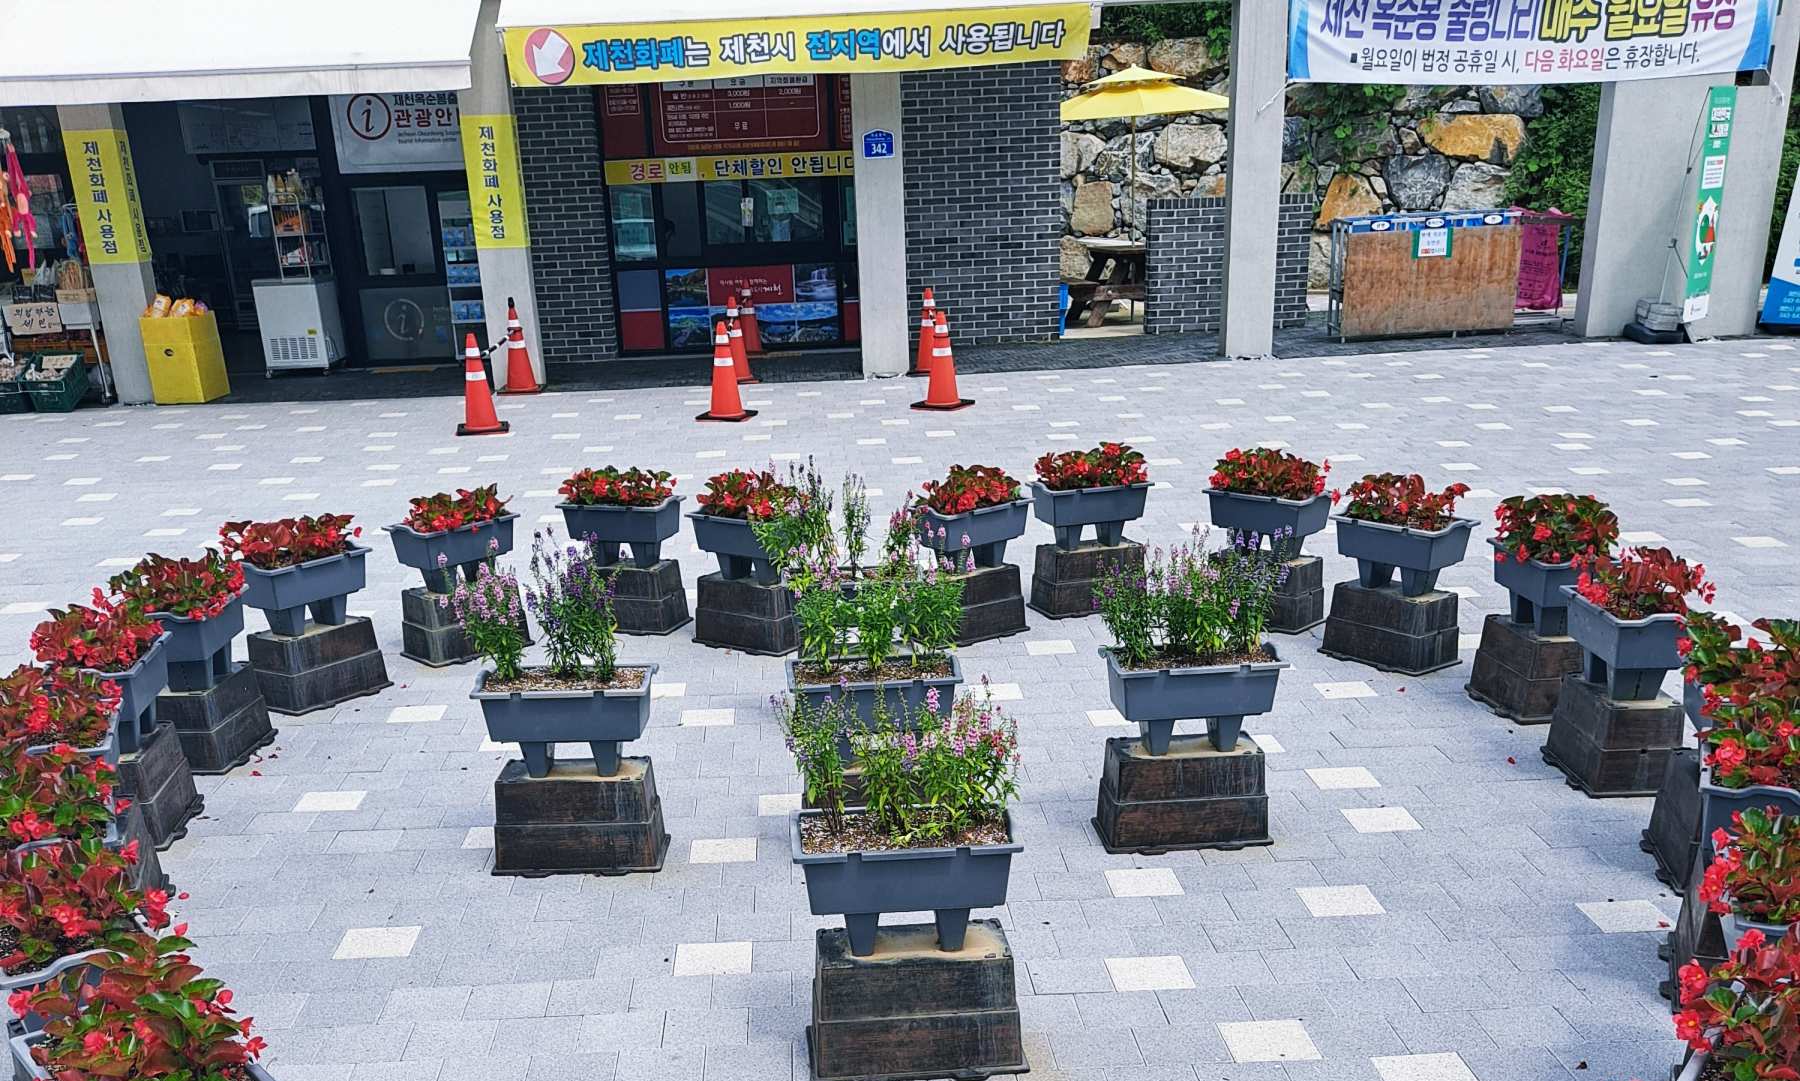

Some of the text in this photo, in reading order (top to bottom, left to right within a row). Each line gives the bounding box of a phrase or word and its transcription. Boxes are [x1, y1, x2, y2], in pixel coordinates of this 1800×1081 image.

[1538, 0, 1602, 43] 매주
[1604, 0, 1690, 41] 월요일
[583, 19, 1066, 71] 제천화폐는 제천시 전지역에서 사용됩니다
[1360, 47, 1417, 73] 월요일이
[1421, 48, 1450, 73] 법정
[1453, 49, 1497, 73] 공휴일
[1524, 49, 1554, 73] 다음
[1557, 47, 1621, 72] 화요일은
[1623, 40, 1700, 69] 휴장합니다.
[394, 108, 460, 127] 관광안
[871, 142, 887, 154] 342
[478, 126, 506, 239] 제천화폐 사용점
[630, 162, 664, 182] 경로
[715, 157, 783, 177] 단체할인
[82, 140, 118, 254] 제천화폐 사용점
